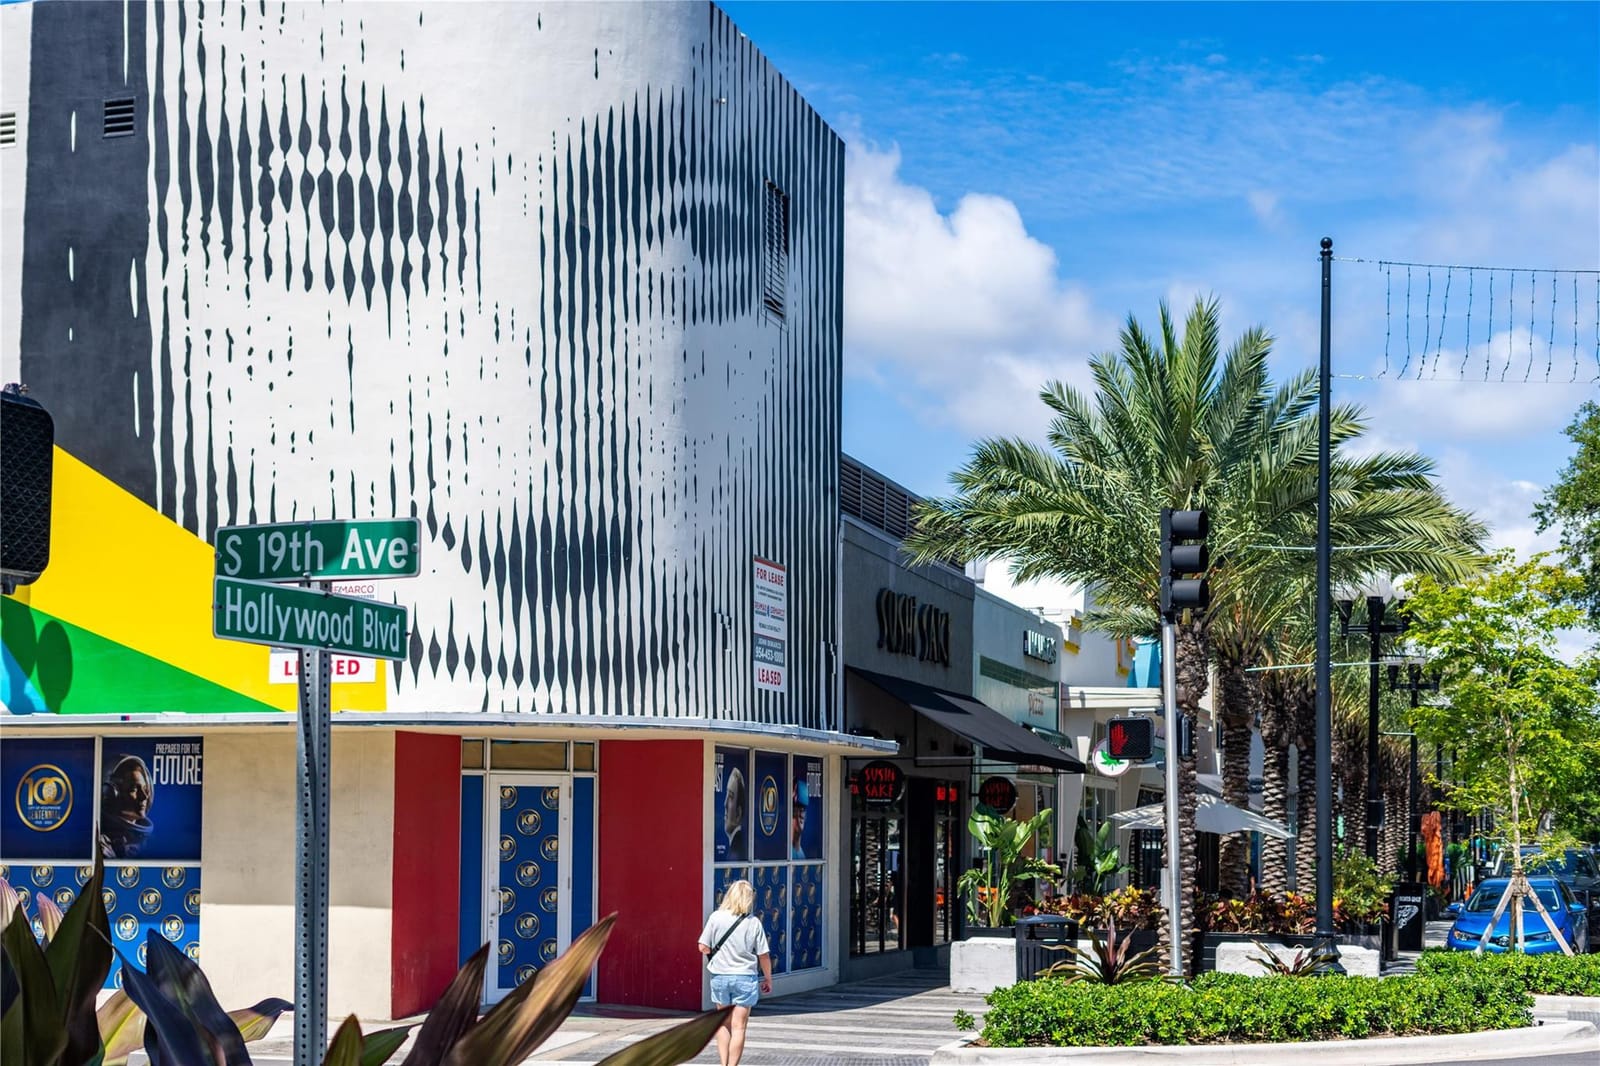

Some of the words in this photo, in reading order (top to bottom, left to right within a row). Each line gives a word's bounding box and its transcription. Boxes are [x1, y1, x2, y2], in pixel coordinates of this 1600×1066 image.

[223, 534, 243, 576] S
[257, 529, 324, 574] 19th
[341, 528, 409, 570] Ave
[756, 567, 768, 581] FOR
[768, 571, 784, 587] LEASE
[332, 584, 375, 594] EMARCO
[225, 586, 354, 646] Hollywood
[362, 606, 400, 653] Blvd
[876, 587, 917, 658] SUSHI
[284, 659, 361, 676] LED
[758, 667, 782, 686] LEASED
[155, 743, 180, 754] PREPARED
[180, 743, 190, 754] FOR
[153, 754, 203, 785] FUTURE
[864, 766, 896, 782] SUSHI
[24, 776, 67, 806] 100
[865, 783, 894, 798] SAKE
